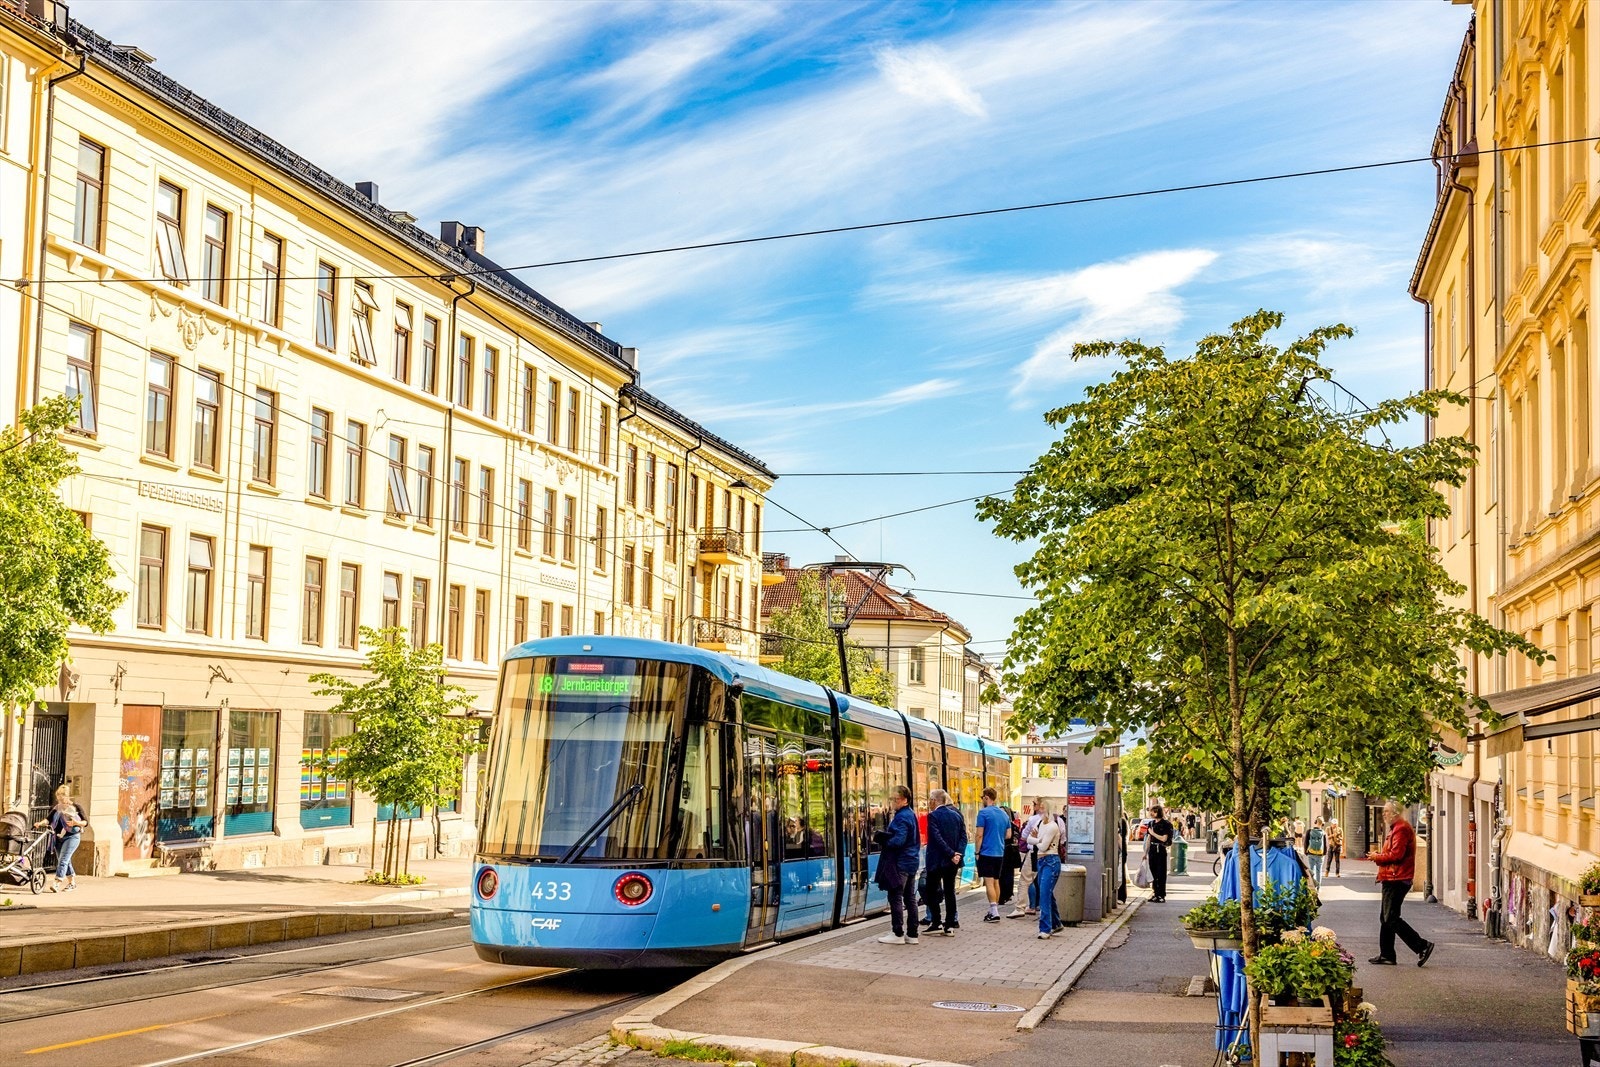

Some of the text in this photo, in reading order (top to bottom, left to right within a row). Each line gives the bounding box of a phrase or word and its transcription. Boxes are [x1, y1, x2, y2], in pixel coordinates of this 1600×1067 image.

[539, 676, 629, 695] 18 Jernbanetorget
[531, 881, 572, 901] 433
[531, 917, 562, 930] CAF
